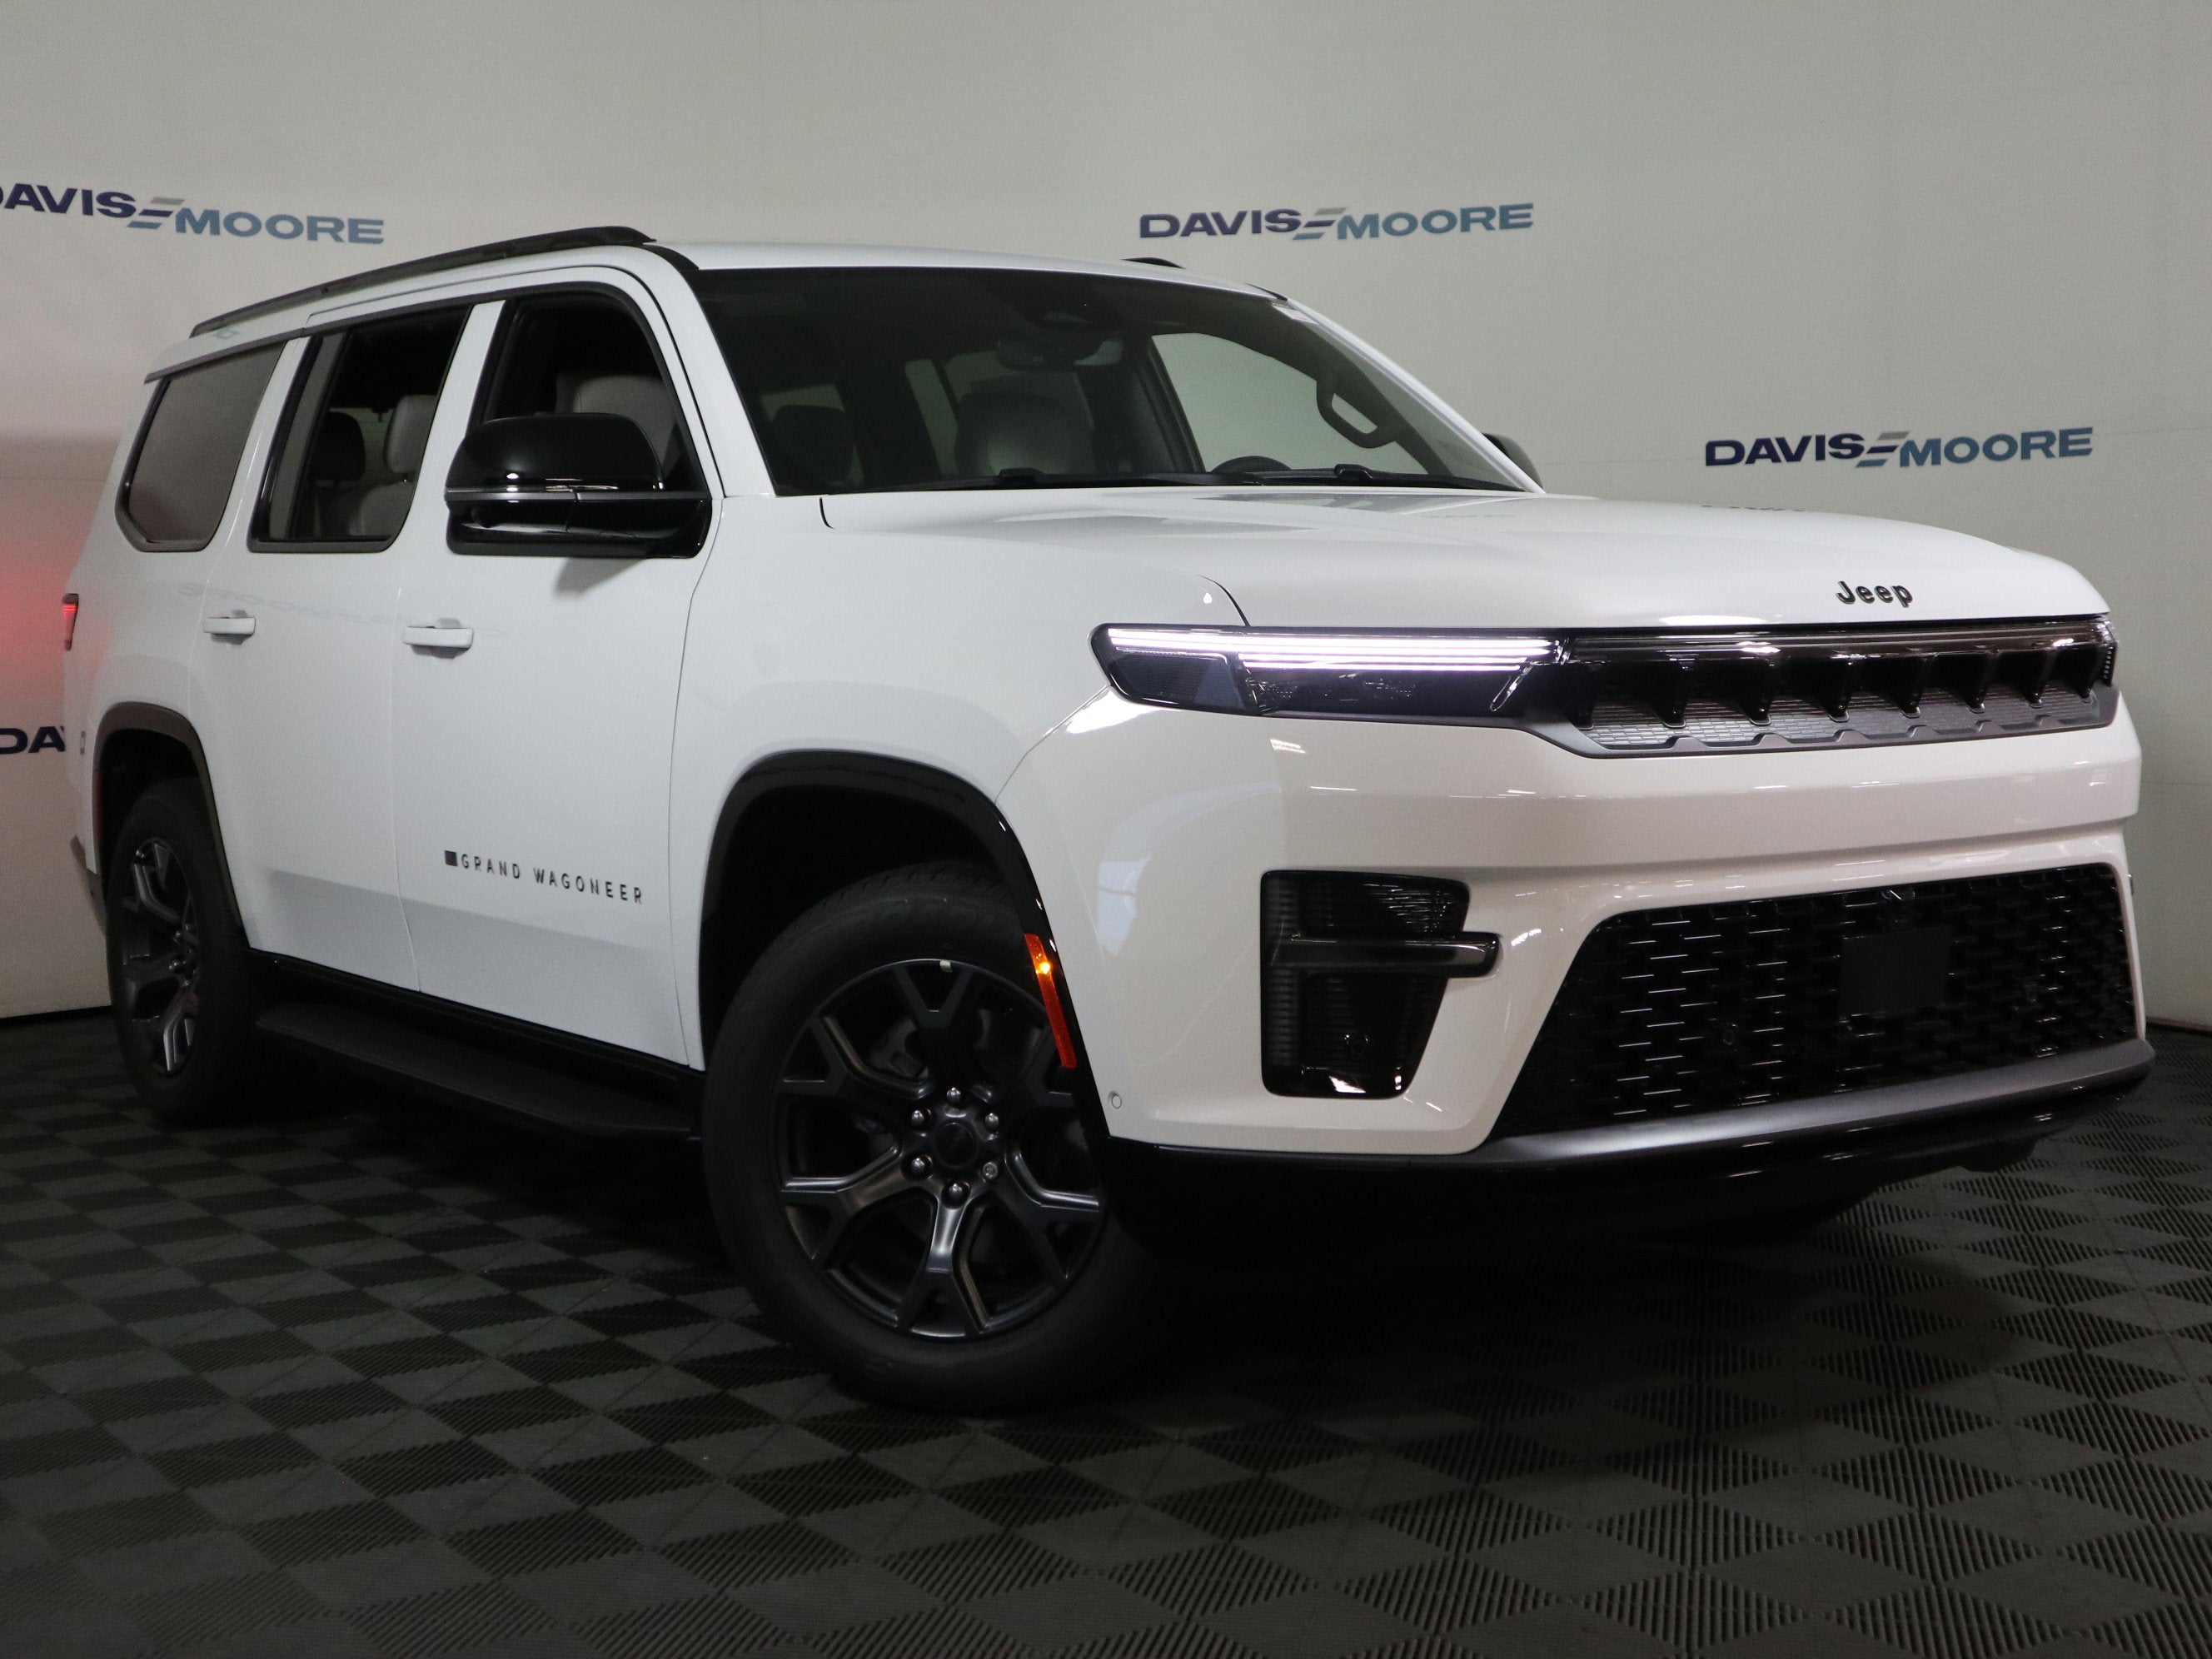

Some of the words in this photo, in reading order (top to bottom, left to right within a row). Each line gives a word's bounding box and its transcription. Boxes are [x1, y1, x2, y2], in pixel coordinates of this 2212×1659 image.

[0, 183, 136, 218] AVIS
[175, 207, 385, 244] MOORE
[1139, 208, 1302, 238] DAVIS
[1337, 203, 1533, 240] MOORE
[1705, 432, 1865, 466] DAVIS
[1900, 426, 2093, 468] MOORE
[1836, 580, 1913, 608] Jeep
[0, 725, 66, 755] DA
[461, 854, 521, 879] GRAND
[533, 867, 642, 904] WAGONEER
